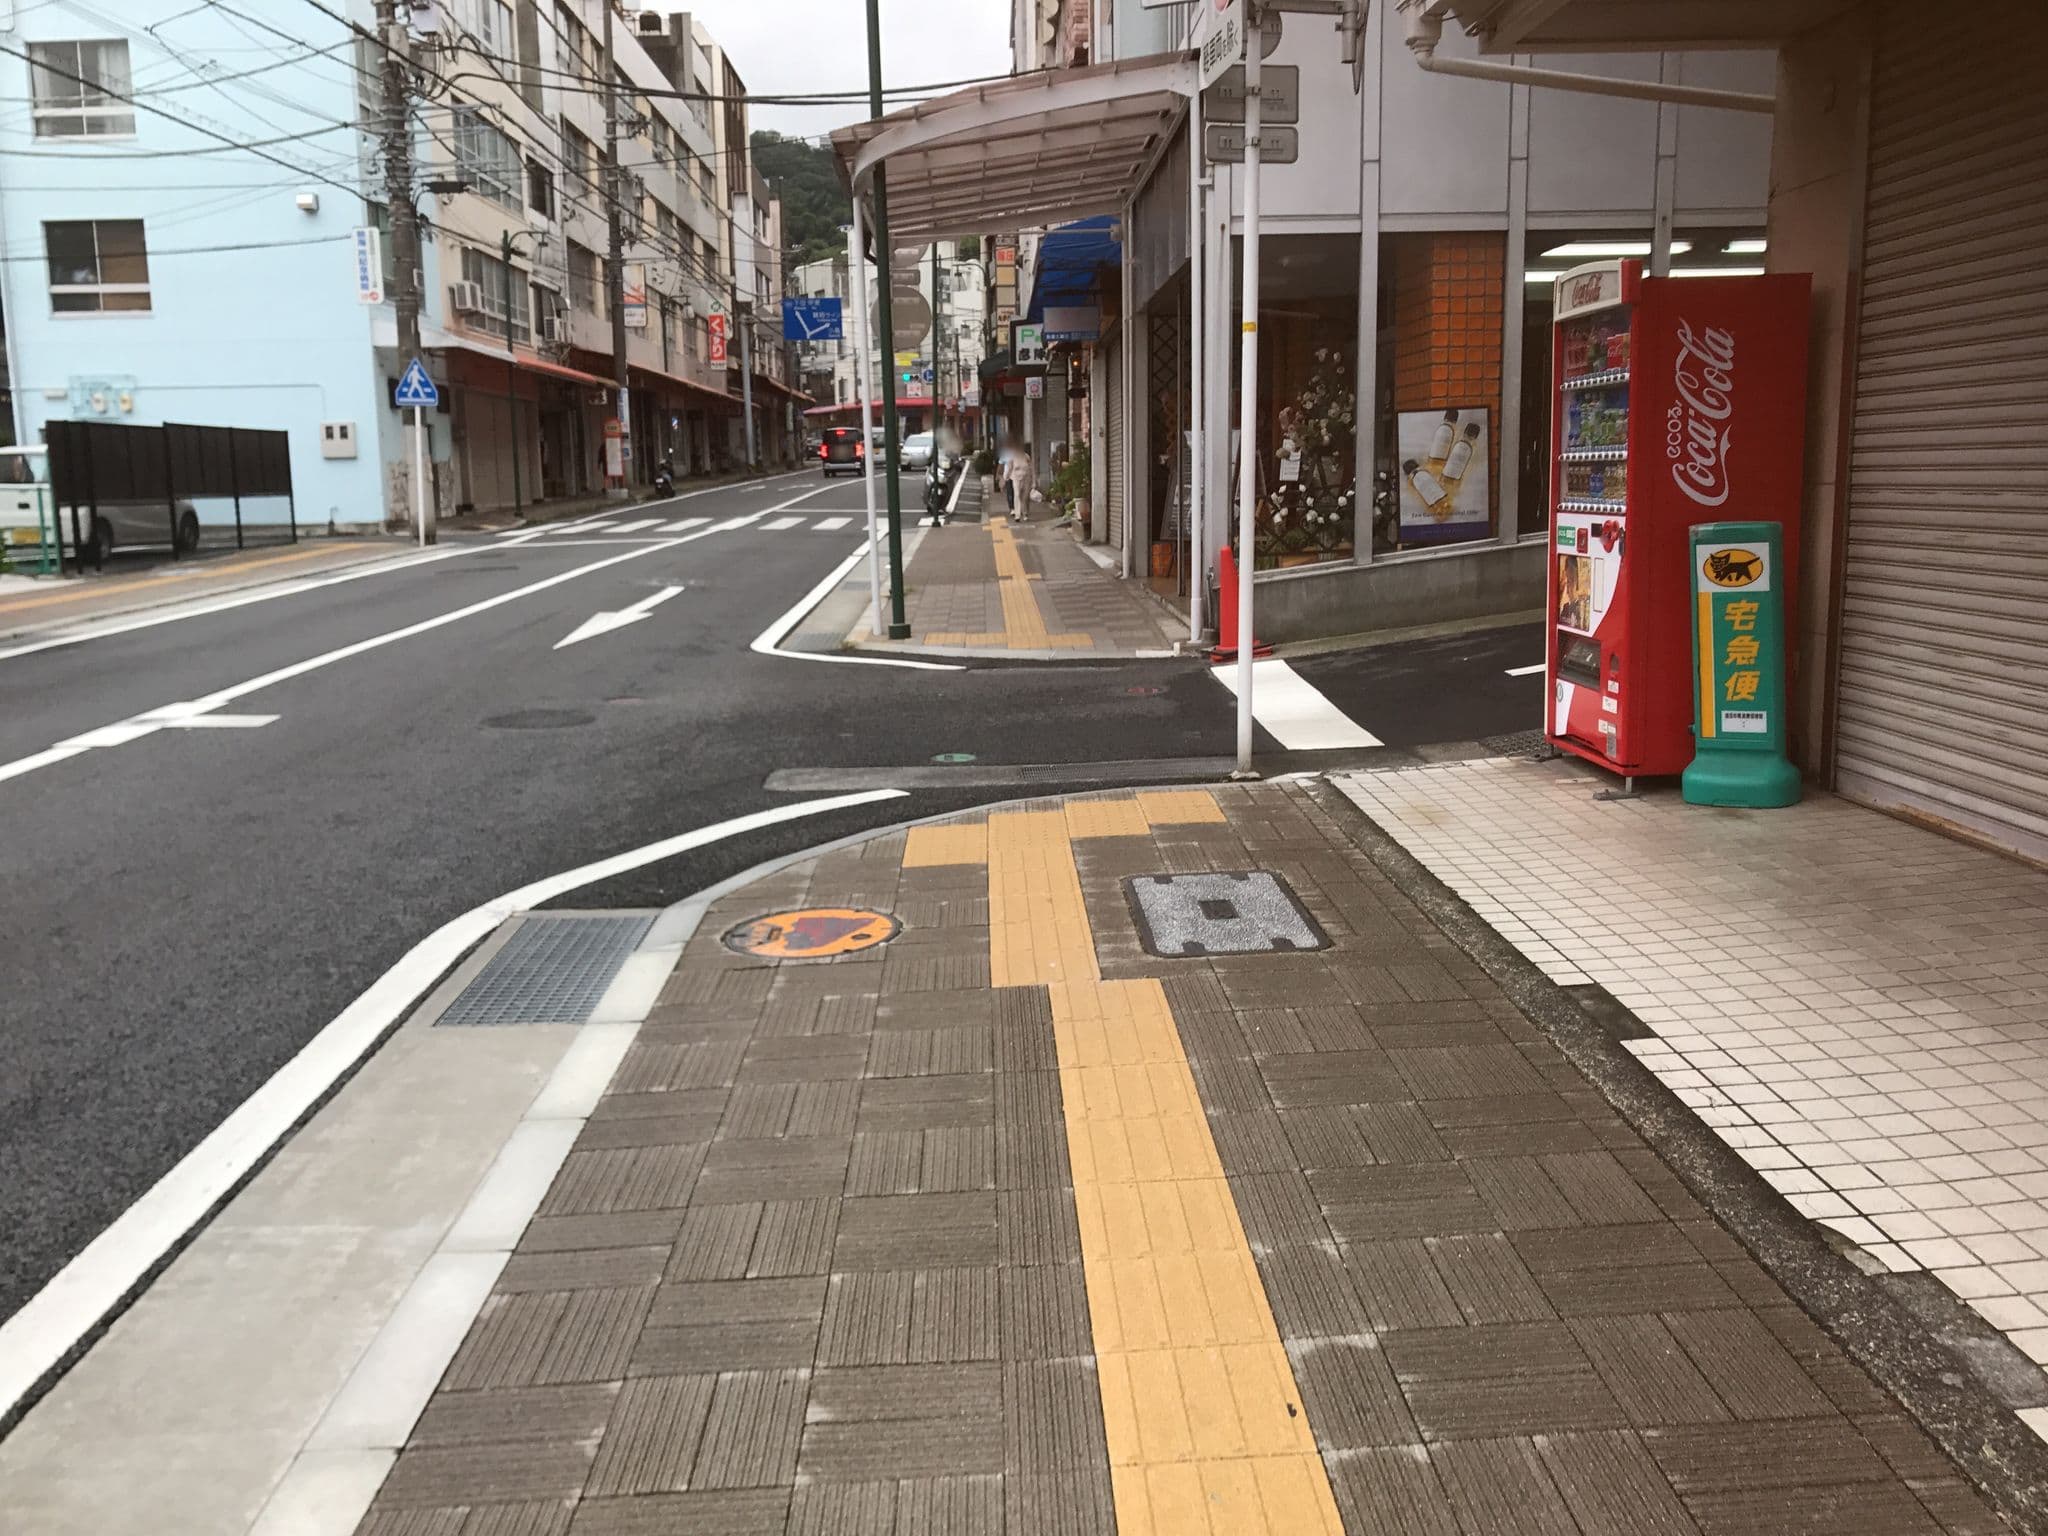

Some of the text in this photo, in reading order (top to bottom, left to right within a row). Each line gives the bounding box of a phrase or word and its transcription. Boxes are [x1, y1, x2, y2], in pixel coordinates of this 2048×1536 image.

[1672, 317, 1735, 507] Coca-Cola
[1723, 599, 1761, 702] 宅急便
